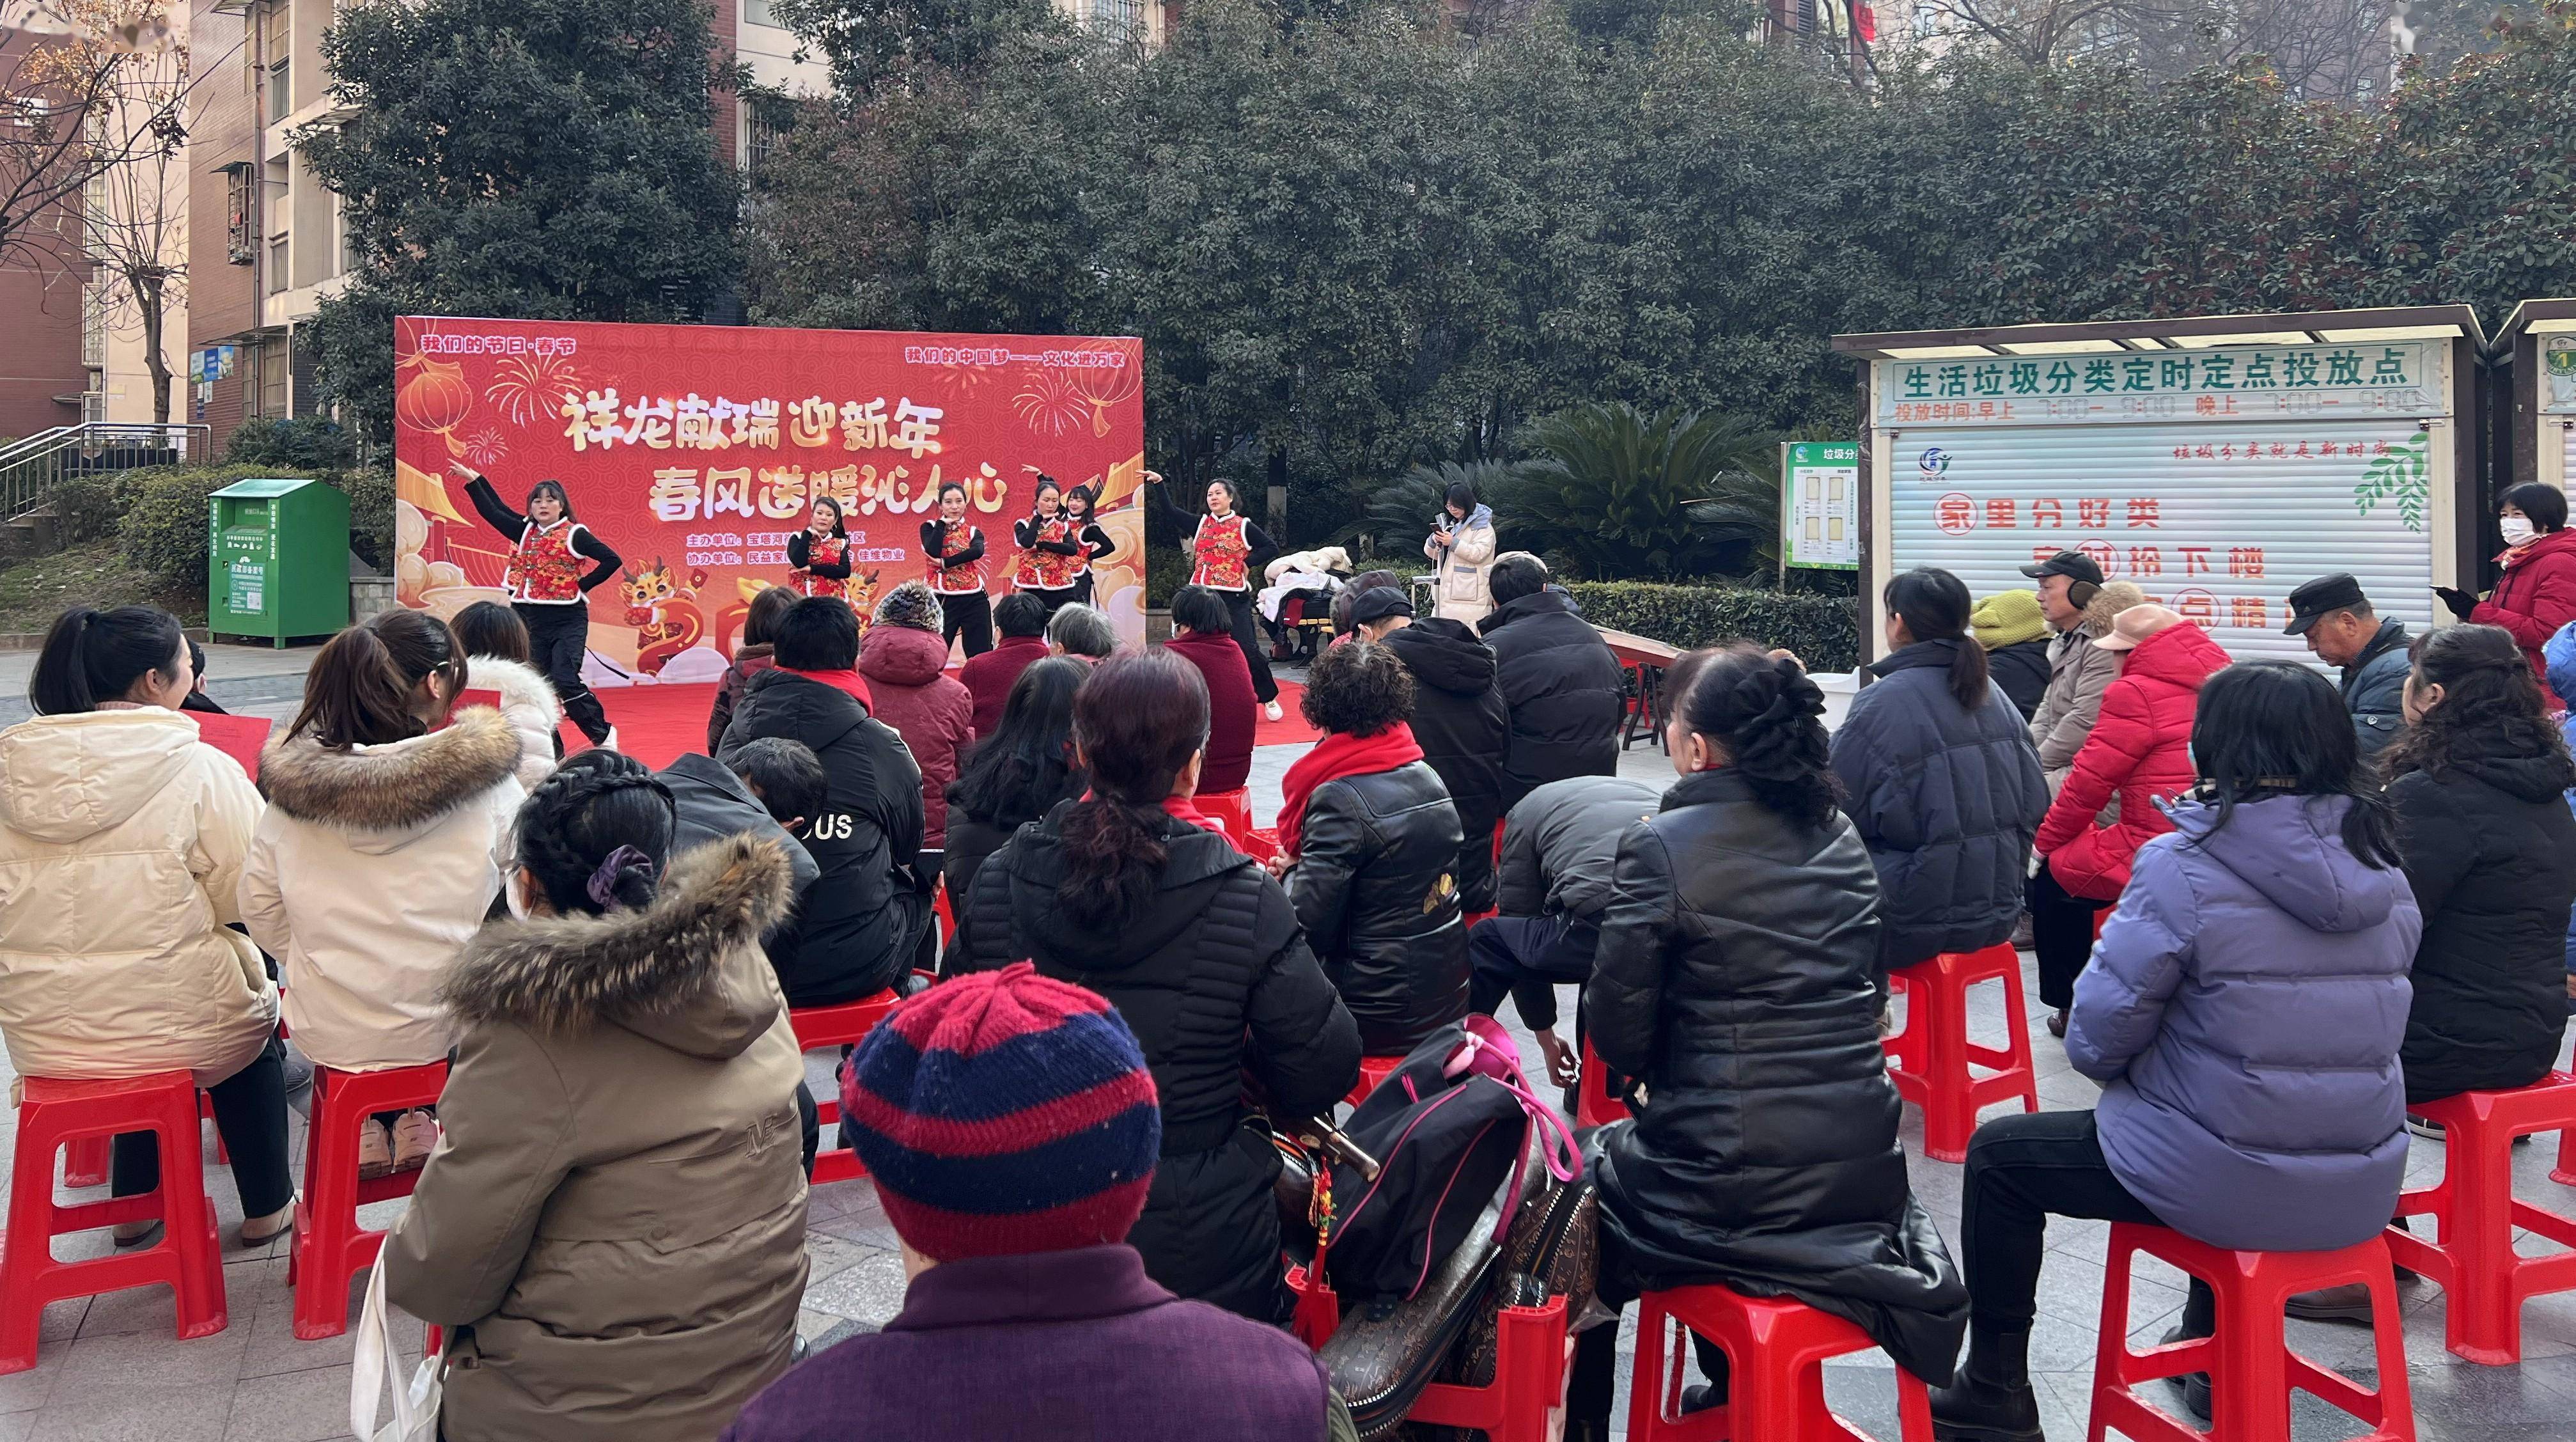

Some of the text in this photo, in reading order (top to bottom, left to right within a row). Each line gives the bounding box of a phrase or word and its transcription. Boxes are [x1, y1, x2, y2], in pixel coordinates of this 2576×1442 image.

[421, 334, 576, 356] 我们的节日·春节
[1904, 348, 2408, 398] 生活垃圾分类定时定点投放点
[2173, 439, 2393, 460] 垃圾分类就是新时尚
[648, 462, 1008, 521] 春风送暖沁人心
[1940, 498, 2161, 528] 家里分好类
[802, 813, 852, 840] US
